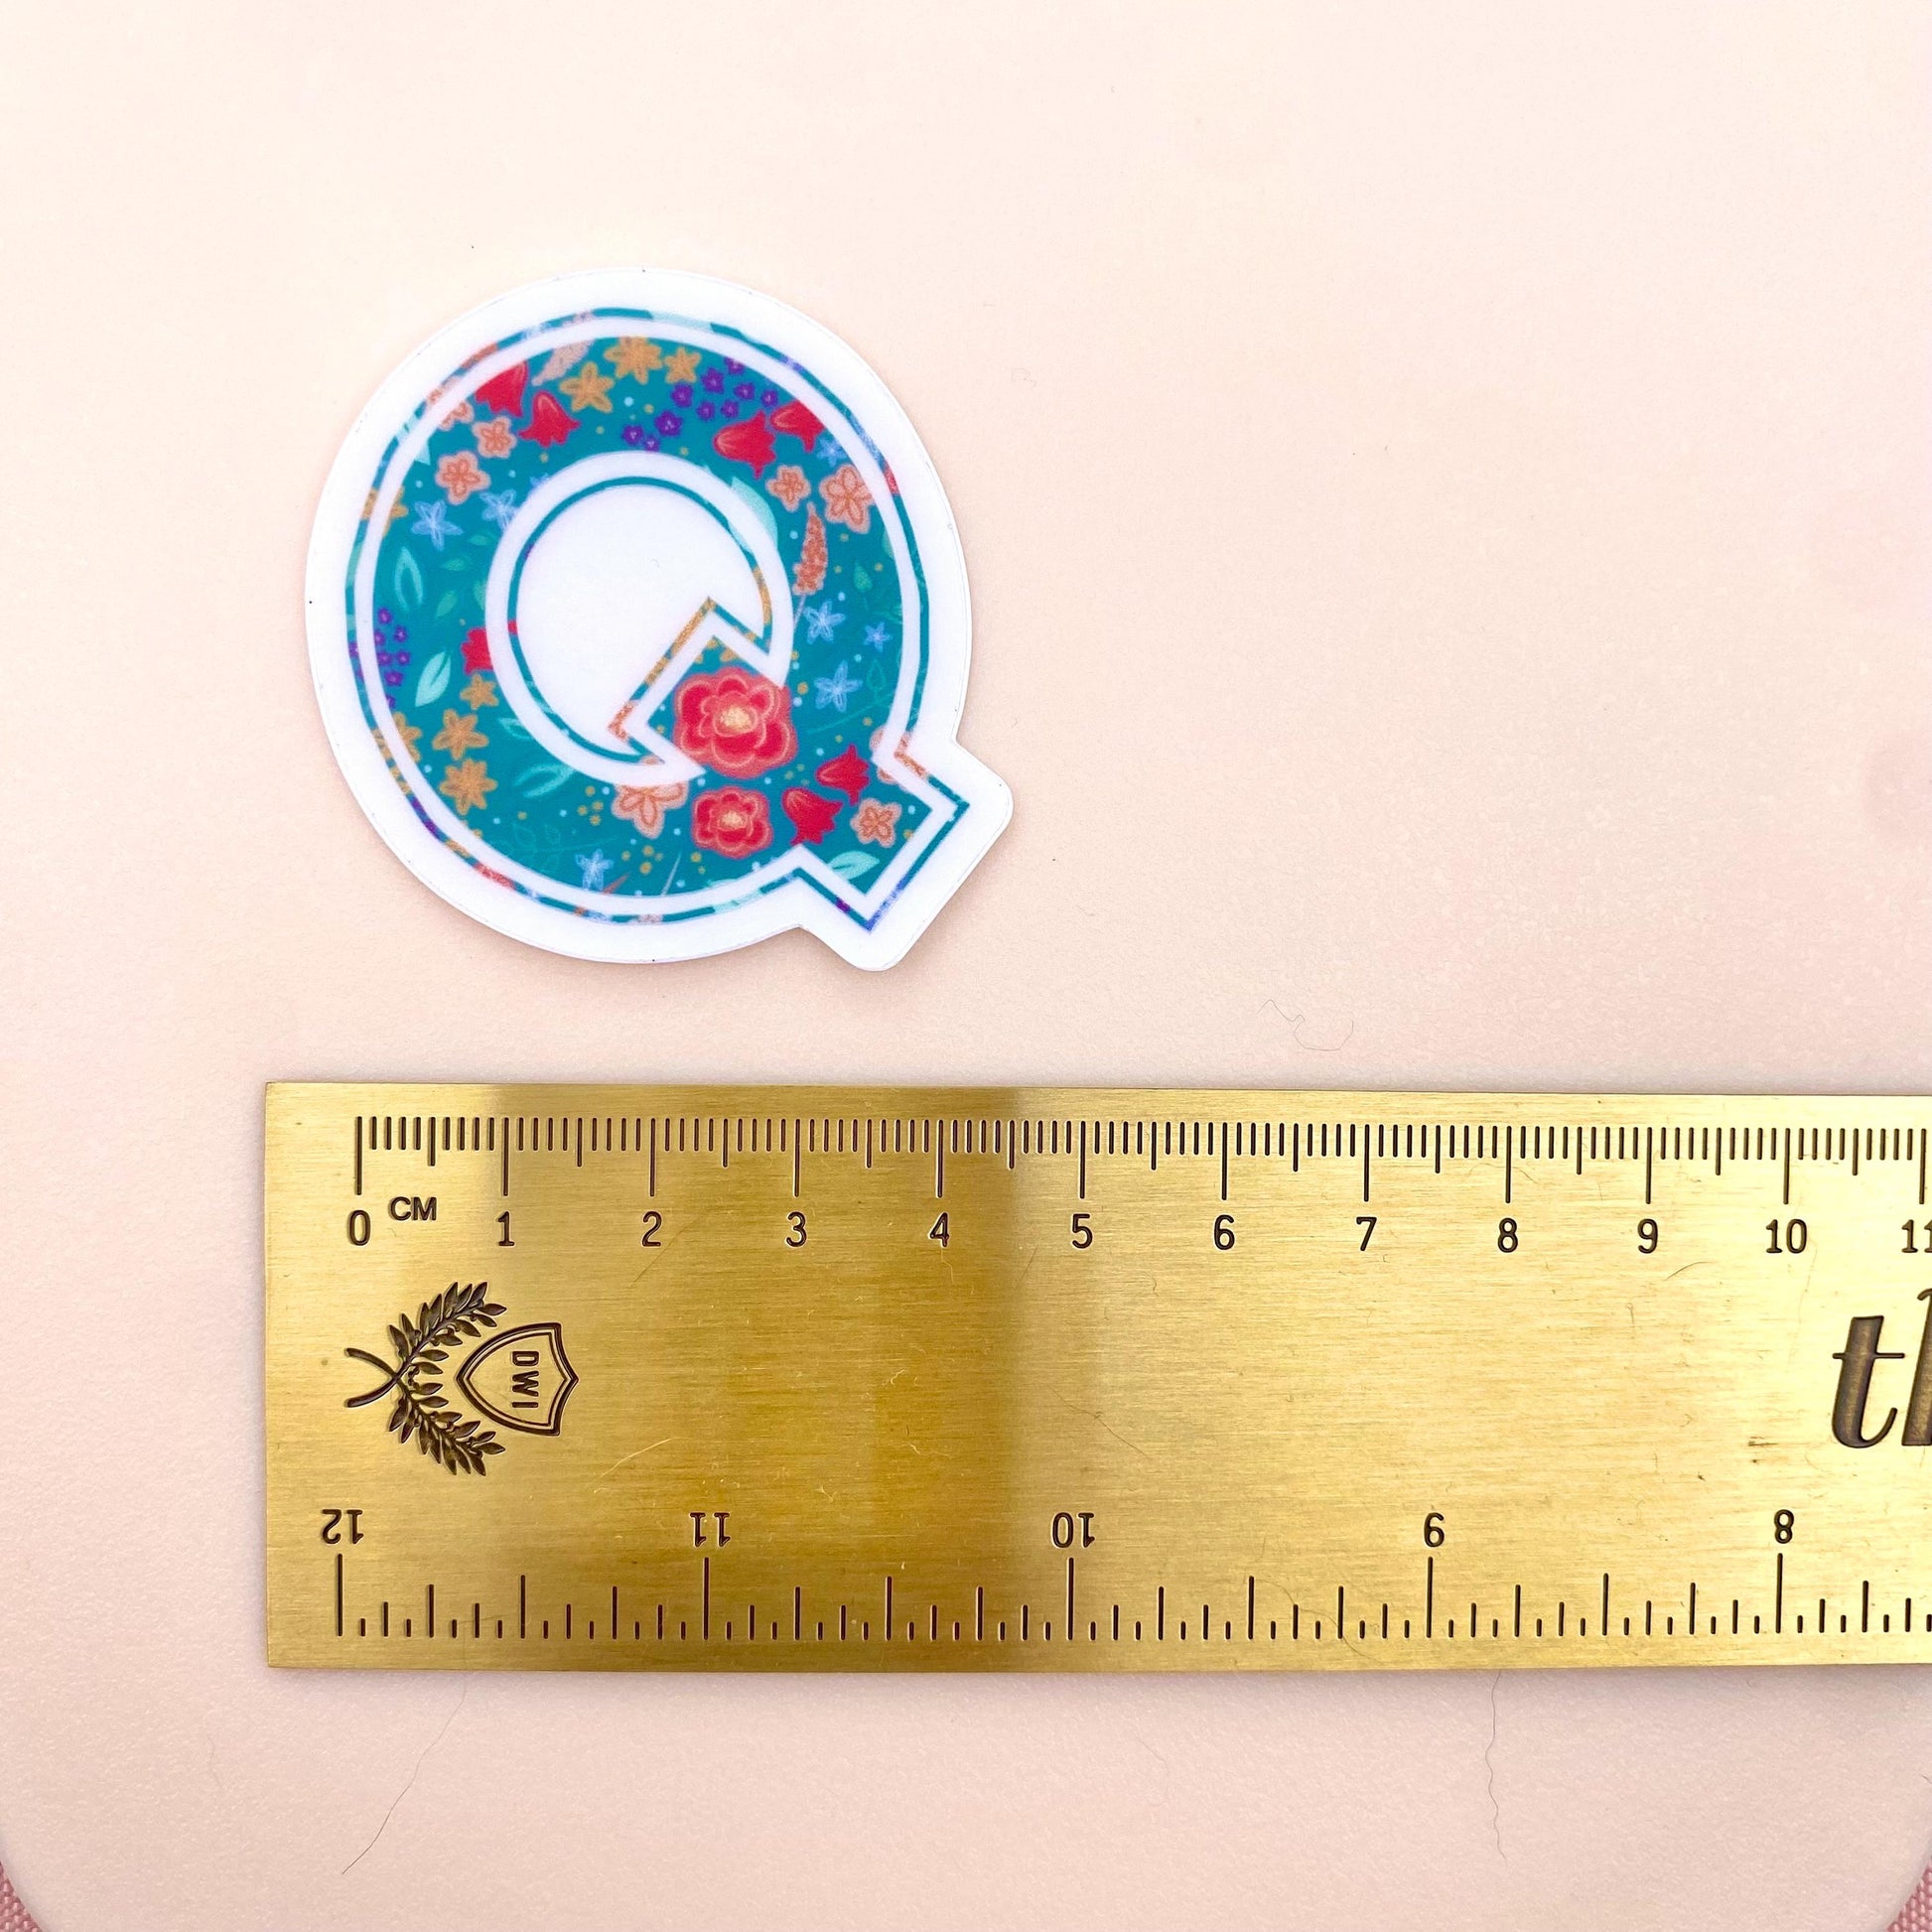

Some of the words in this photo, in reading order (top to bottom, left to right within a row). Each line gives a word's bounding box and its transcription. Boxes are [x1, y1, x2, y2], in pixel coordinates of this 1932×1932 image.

[345, 308, 970, 929] Q
[390, 1196, 437, 1221] CM
[348, 1209, 371, 1247] 0
[497, 1210, 515, 1247] 1
[641, 1210, 662, 1247] 2
[785, 1211, 807, 1248] 3
[929, 1212, 950, 1248] 4
[1071, 1213, 1093, 1249] 5
[1213, 1214, 1235, 1251] 6
[1355, 1216, 1378, 1252] 7
[1497, 1217, 1519, 1254] 8
[1637, 1218, 1659, 1254] 9
[1765, 1218, 1808, 1254] 10
[511, 1350, 540, 1409] DWI
[322, 1508, 364, 1545] 12
[689, 1512, 731, 1548] 11
[1052, 1512, 1095, 1549] 10
[1773, 1509, 1795, 1545] 8
